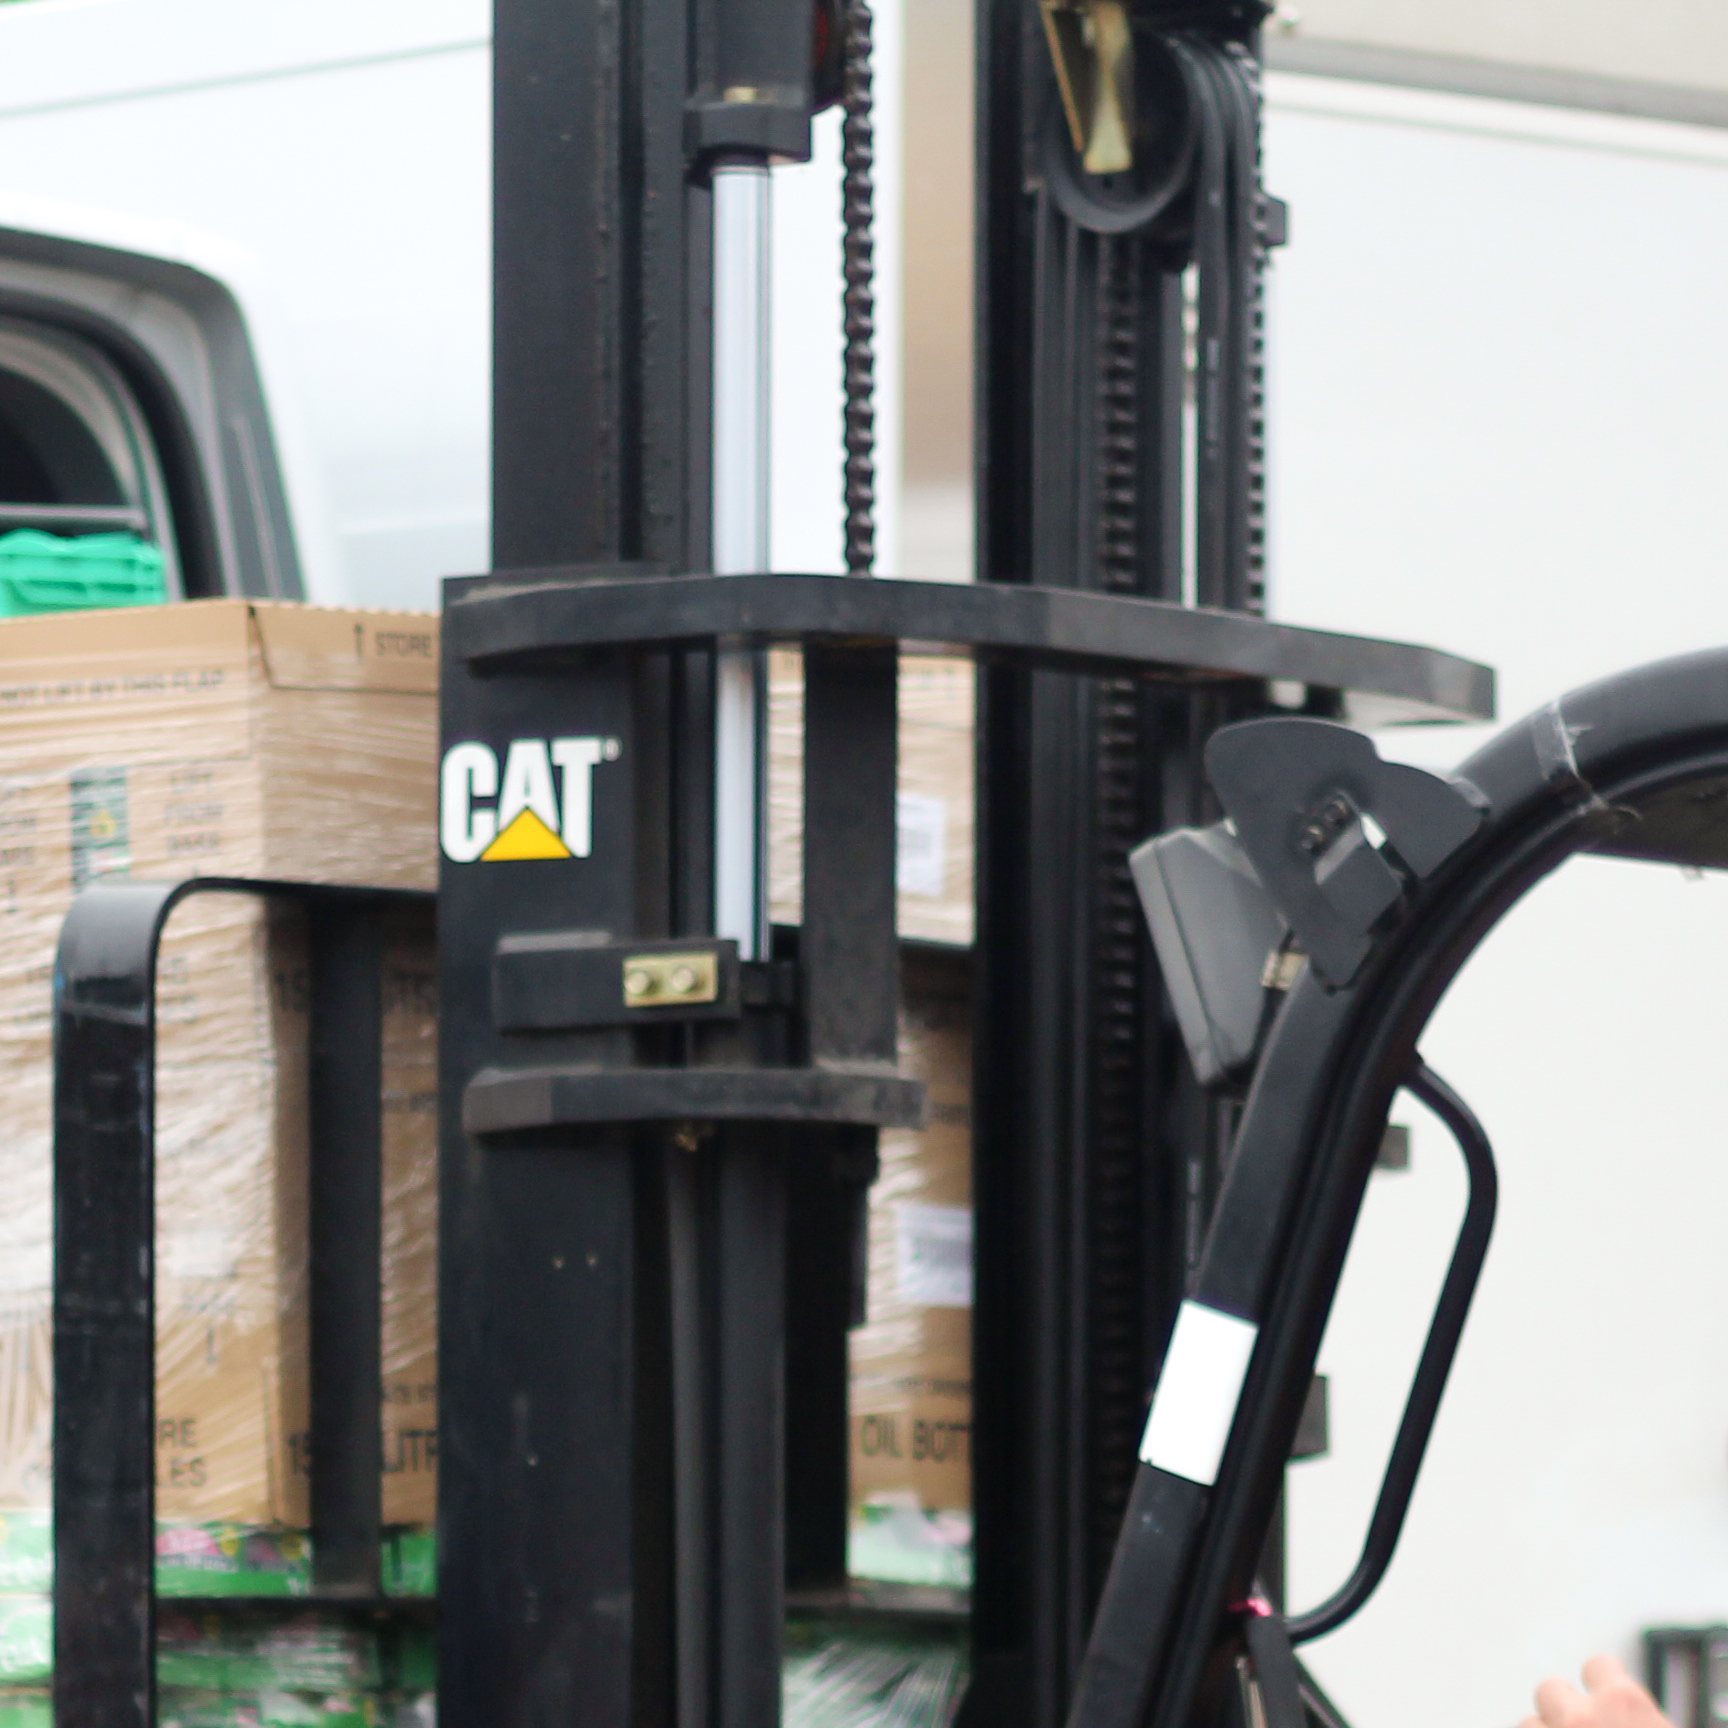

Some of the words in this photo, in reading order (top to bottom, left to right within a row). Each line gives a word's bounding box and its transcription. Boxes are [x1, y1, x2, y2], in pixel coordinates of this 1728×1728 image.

[376, 631, 433, 658] STORE
[440, 737, 603, 863] CAT
[861, 1414, 904, 1458] OIL
